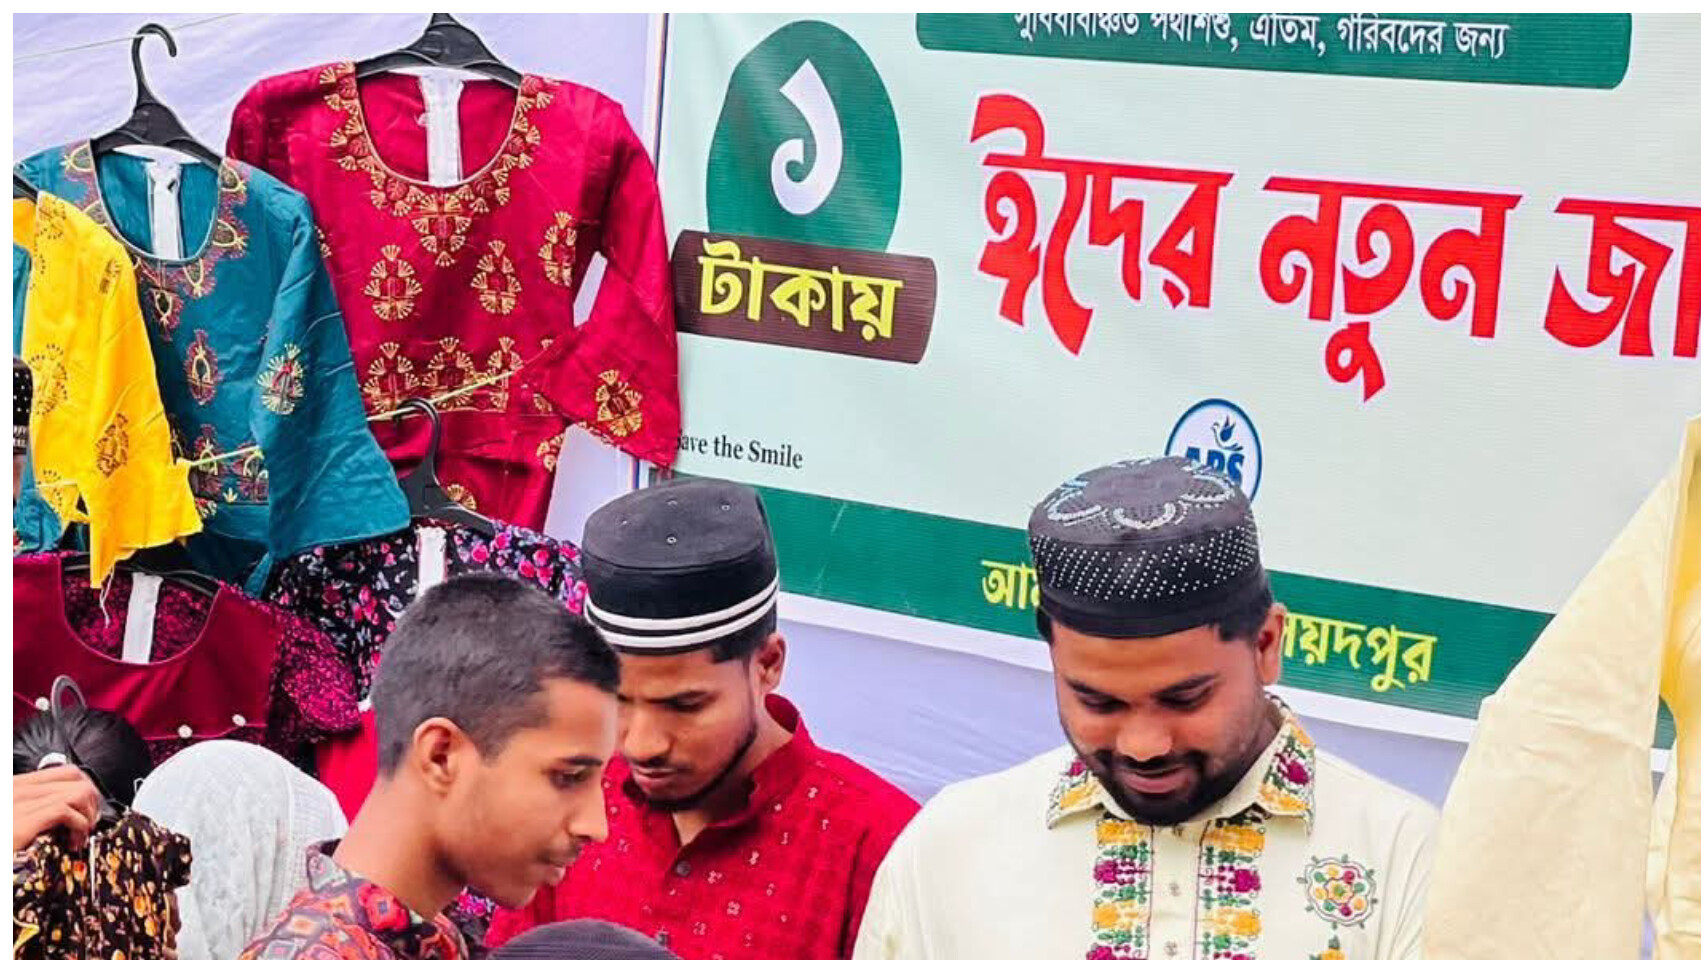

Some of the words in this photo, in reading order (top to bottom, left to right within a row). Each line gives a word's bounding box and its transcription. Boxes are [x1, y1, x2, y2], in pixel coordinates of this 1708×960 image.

[1338, 13, 1446, 55] গরিবদের
[1453, 22, 1510, 59] জন্য
[770, 58, 843, 215] ১
[698, 238, 904, 341] টাকায়
[971, 93, 1234, 356] ঈদের
[1259, 176, 1523, 402] নতুন
[1543, 198, 1702, 358] জা
[713, 434, 744, 460] the
[747, 440, 803, 469] Smile
[1281, 612, 1437, 693] য়দপুর
